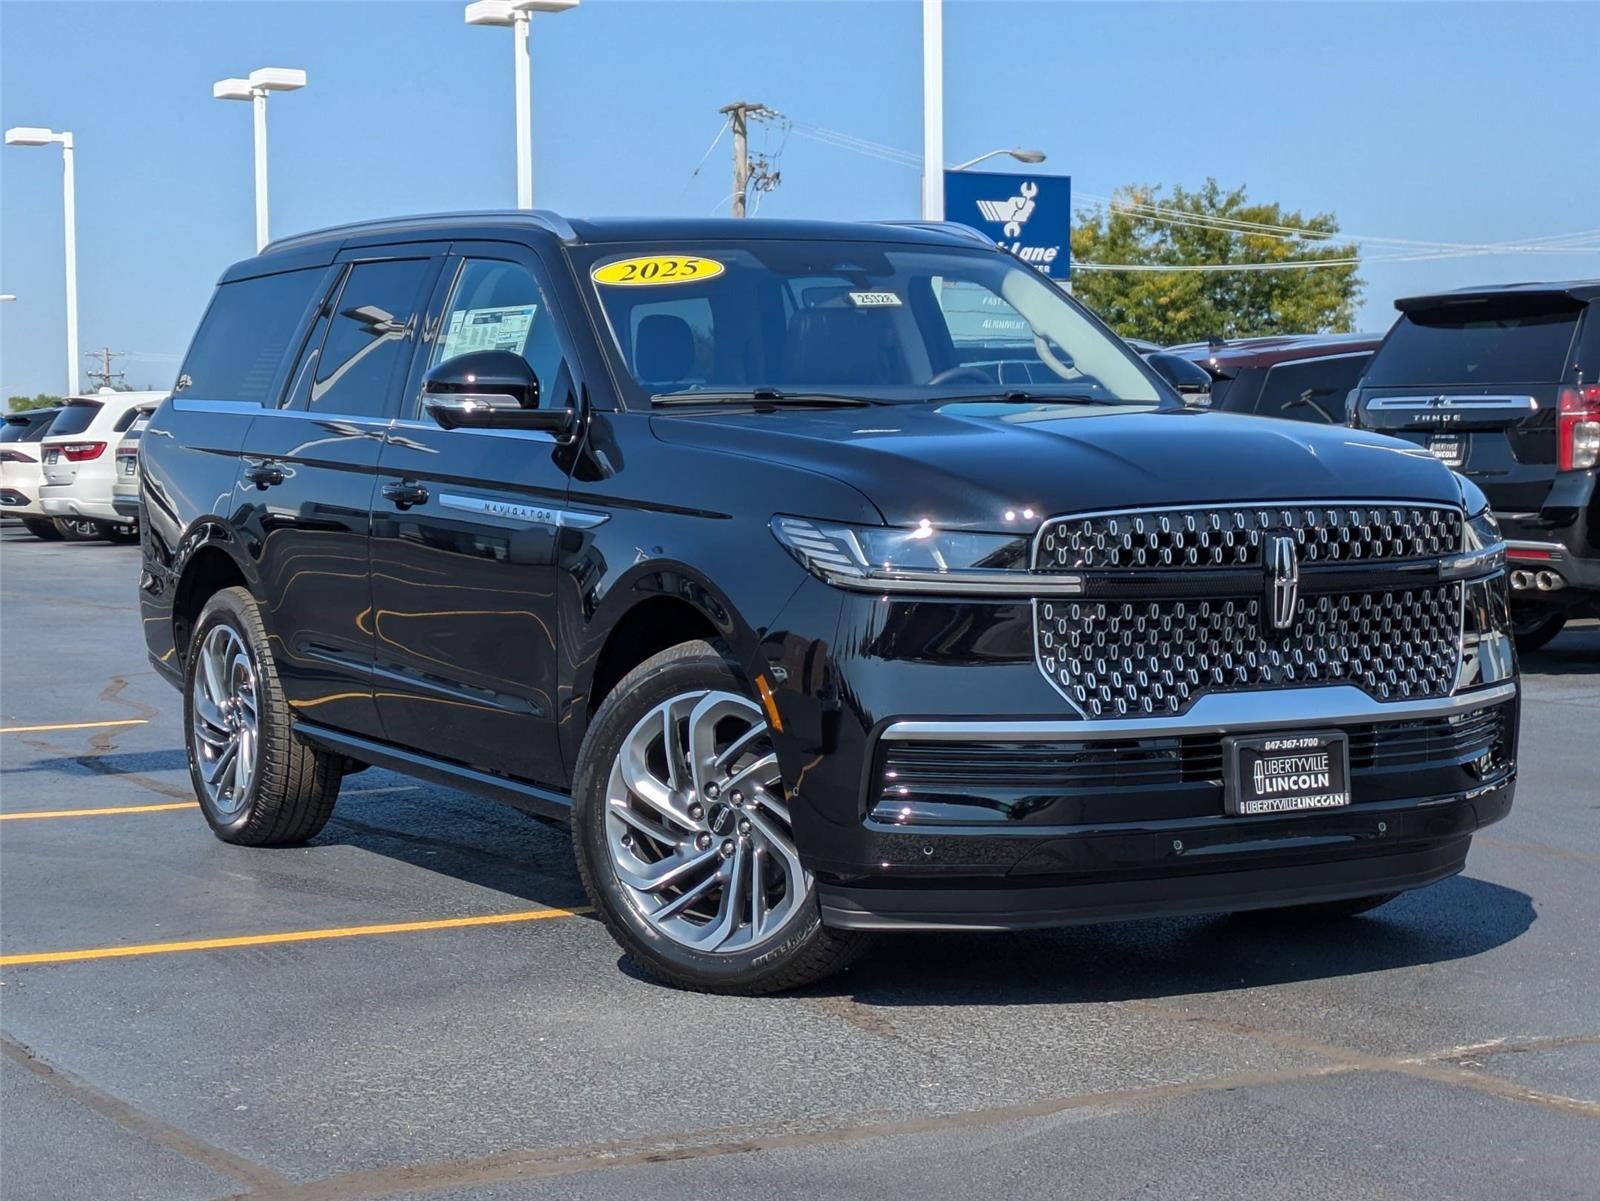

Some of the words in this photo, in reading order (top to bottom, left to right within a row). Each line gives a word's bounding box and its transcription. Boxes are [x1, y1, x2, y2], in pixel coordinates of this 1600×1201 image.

[619, 260, 699, 281] 2025
[484, 503, 551, 519] NAVIGATOR
[1265, 738, 1318, 750] 847-367-1700
[1264, 756, 1328, 775] LIBERTYVILLE
[1265, 773, 1329, 792] LINCOLN
